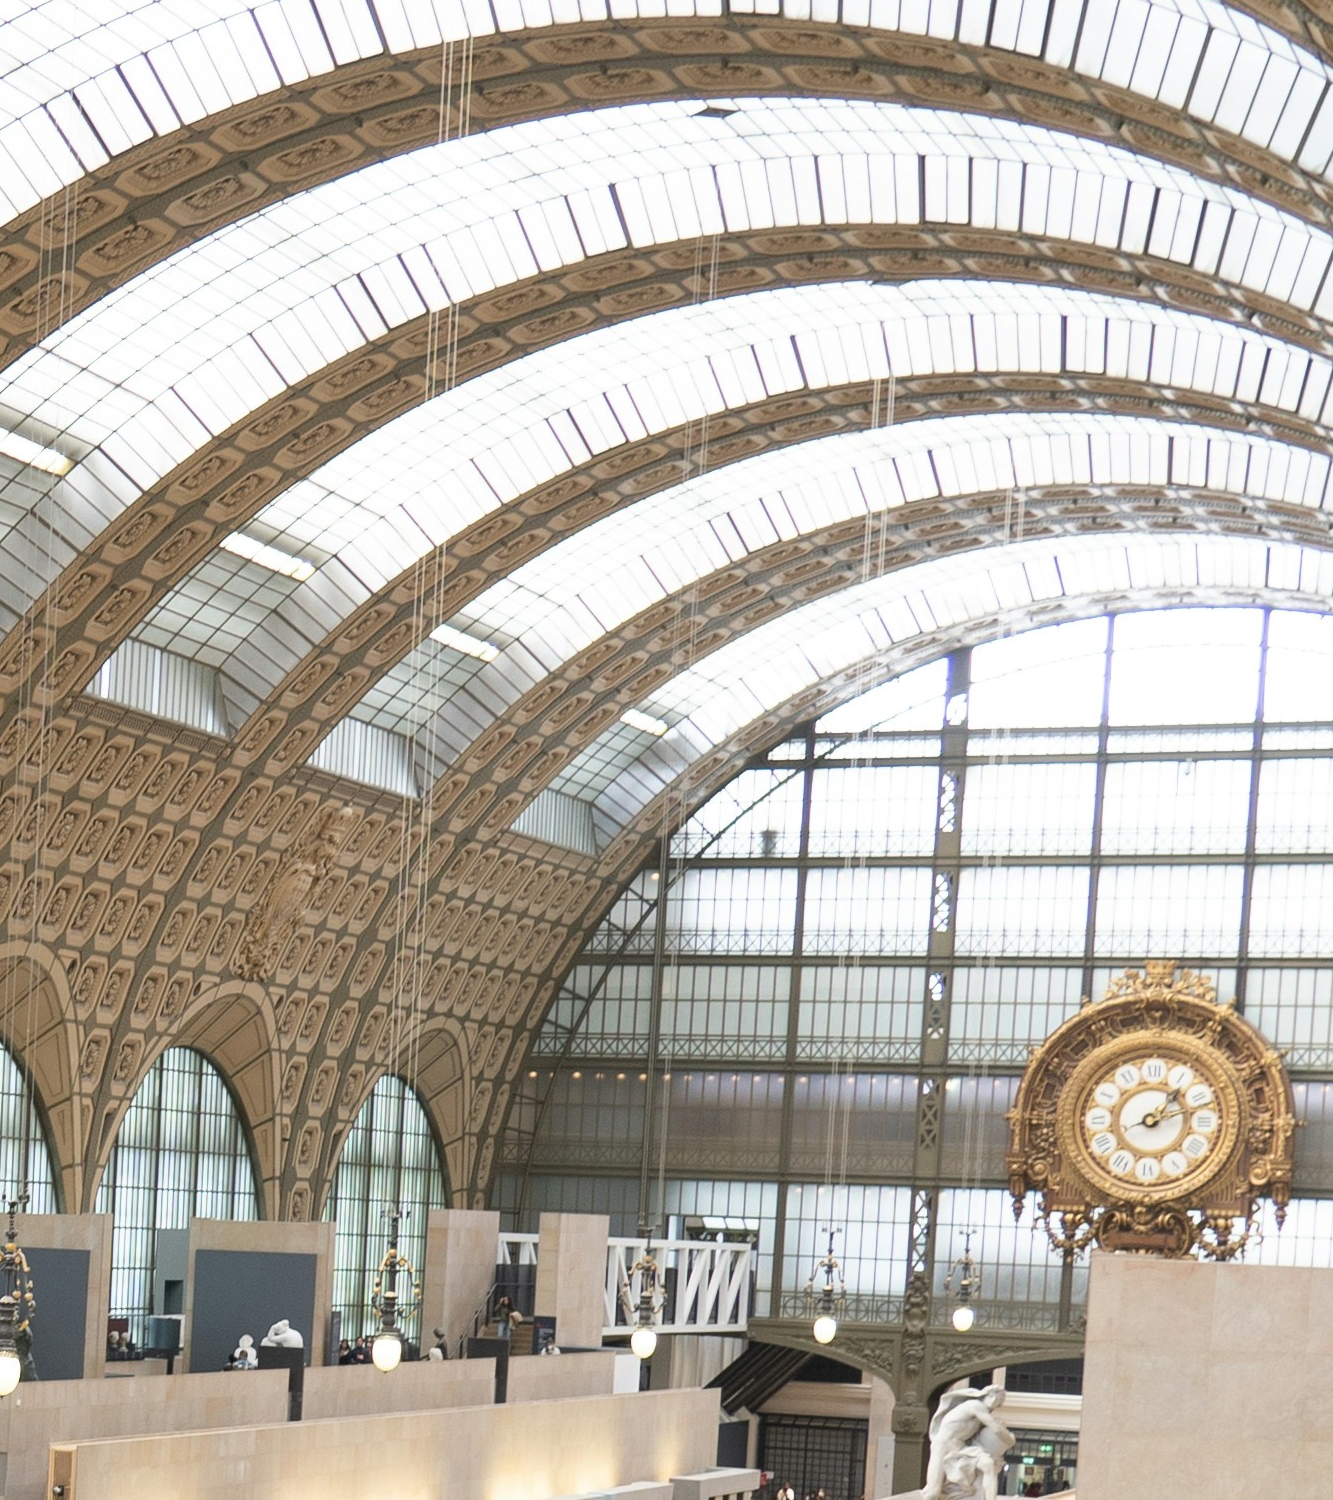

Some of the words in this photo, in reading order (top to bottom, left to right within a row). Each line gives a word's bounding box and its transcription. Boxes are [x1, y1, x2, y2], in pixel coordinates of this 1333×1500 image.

[1147, 1065, 1162, 1077] XII
[1176, 1072, 1185, 1084] I
[1192, 1091, 1206, 1103] II
[1197, 1116, 1212, 1128] III
[1185, 1137, 1205, 1157] IIII
